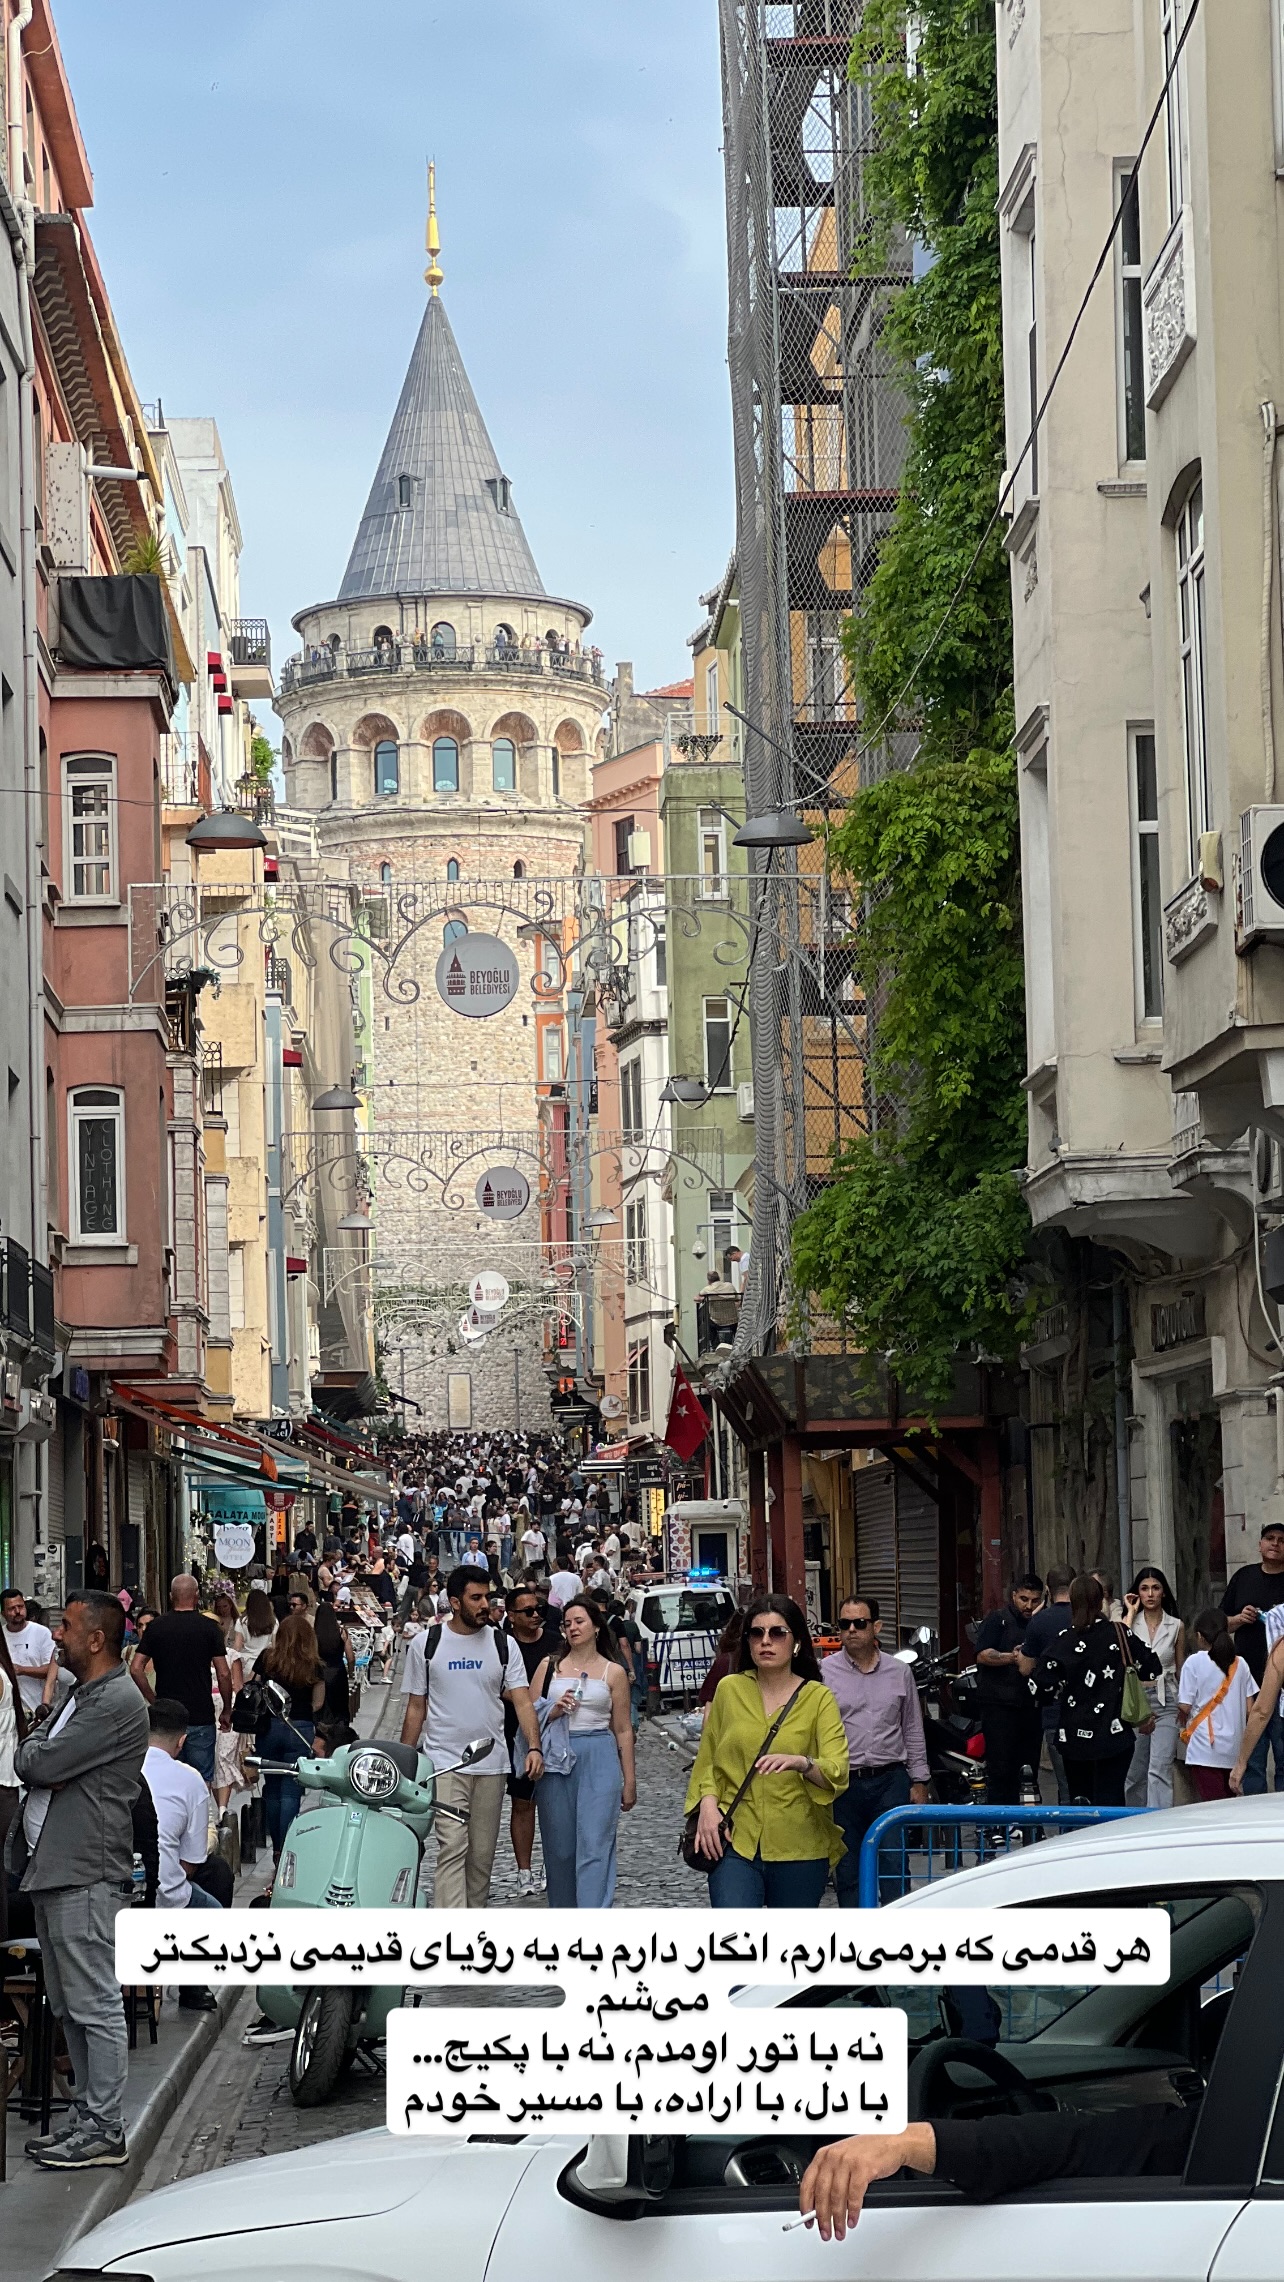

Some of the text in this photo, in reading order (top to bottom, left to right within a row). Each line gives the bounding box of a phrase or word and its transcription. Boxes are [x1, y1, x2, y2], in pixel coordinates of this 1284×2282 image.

[470, 967, 509, 984] BEYOĞLU
[470, 983, 510, 995] BELEDİYESİ
[83, 1122, 97, 1231] VINTAGE
[100, 1121, 113, 1230] CLOTHING
[496, 1187, 522, 1199] BEYOĞLU
[219, 1538, 251, 1547] MOON
[449, 1657, 483, 1670] miav
